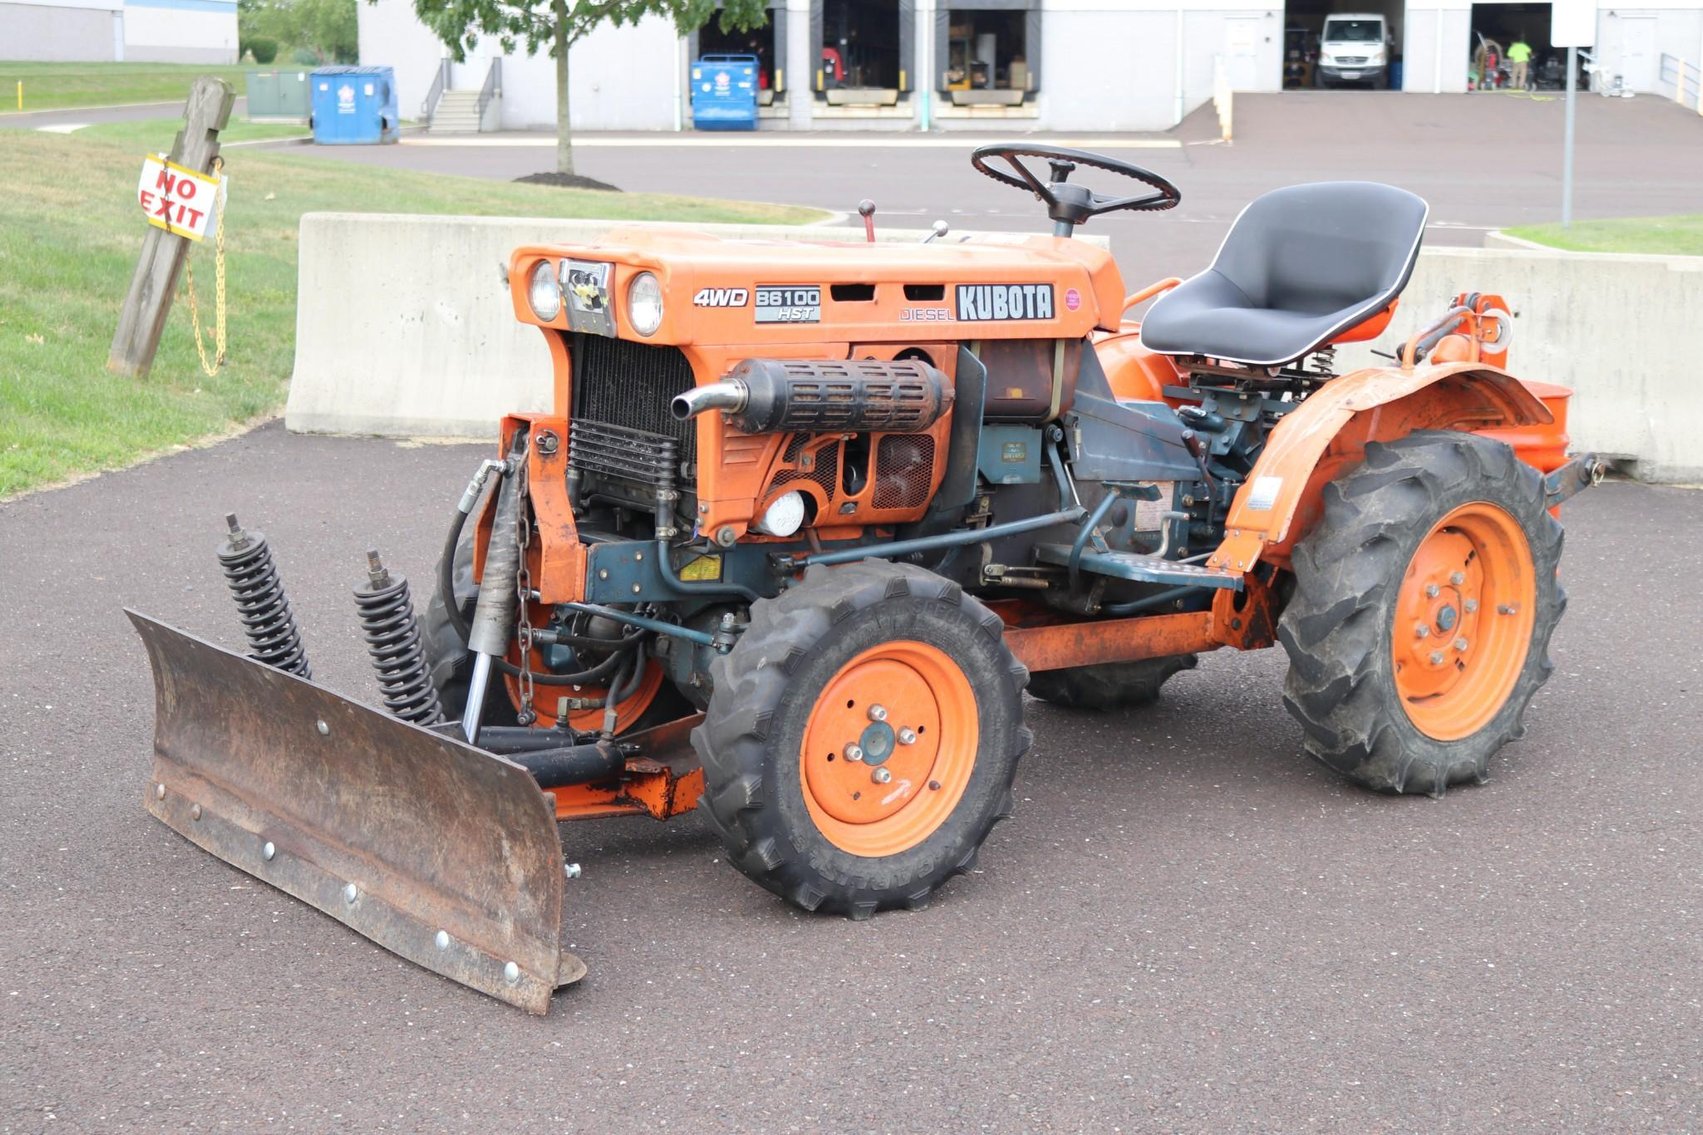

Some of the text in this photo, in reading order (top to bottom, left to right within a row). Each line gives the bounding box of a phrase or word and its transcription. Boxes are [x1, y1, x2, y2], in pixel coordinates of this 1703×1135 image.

[156, 169, 197, 201] NO
[140, 190, 205, 229] EXIT
[694, 288, 749, 307] 4WD
[756, 290, 820, 306] B6100
[958, 285, 1053, 321] KUBOTA
[777, 306, 814, 321] HST
[899, 308, 955, 321] DIESEL
